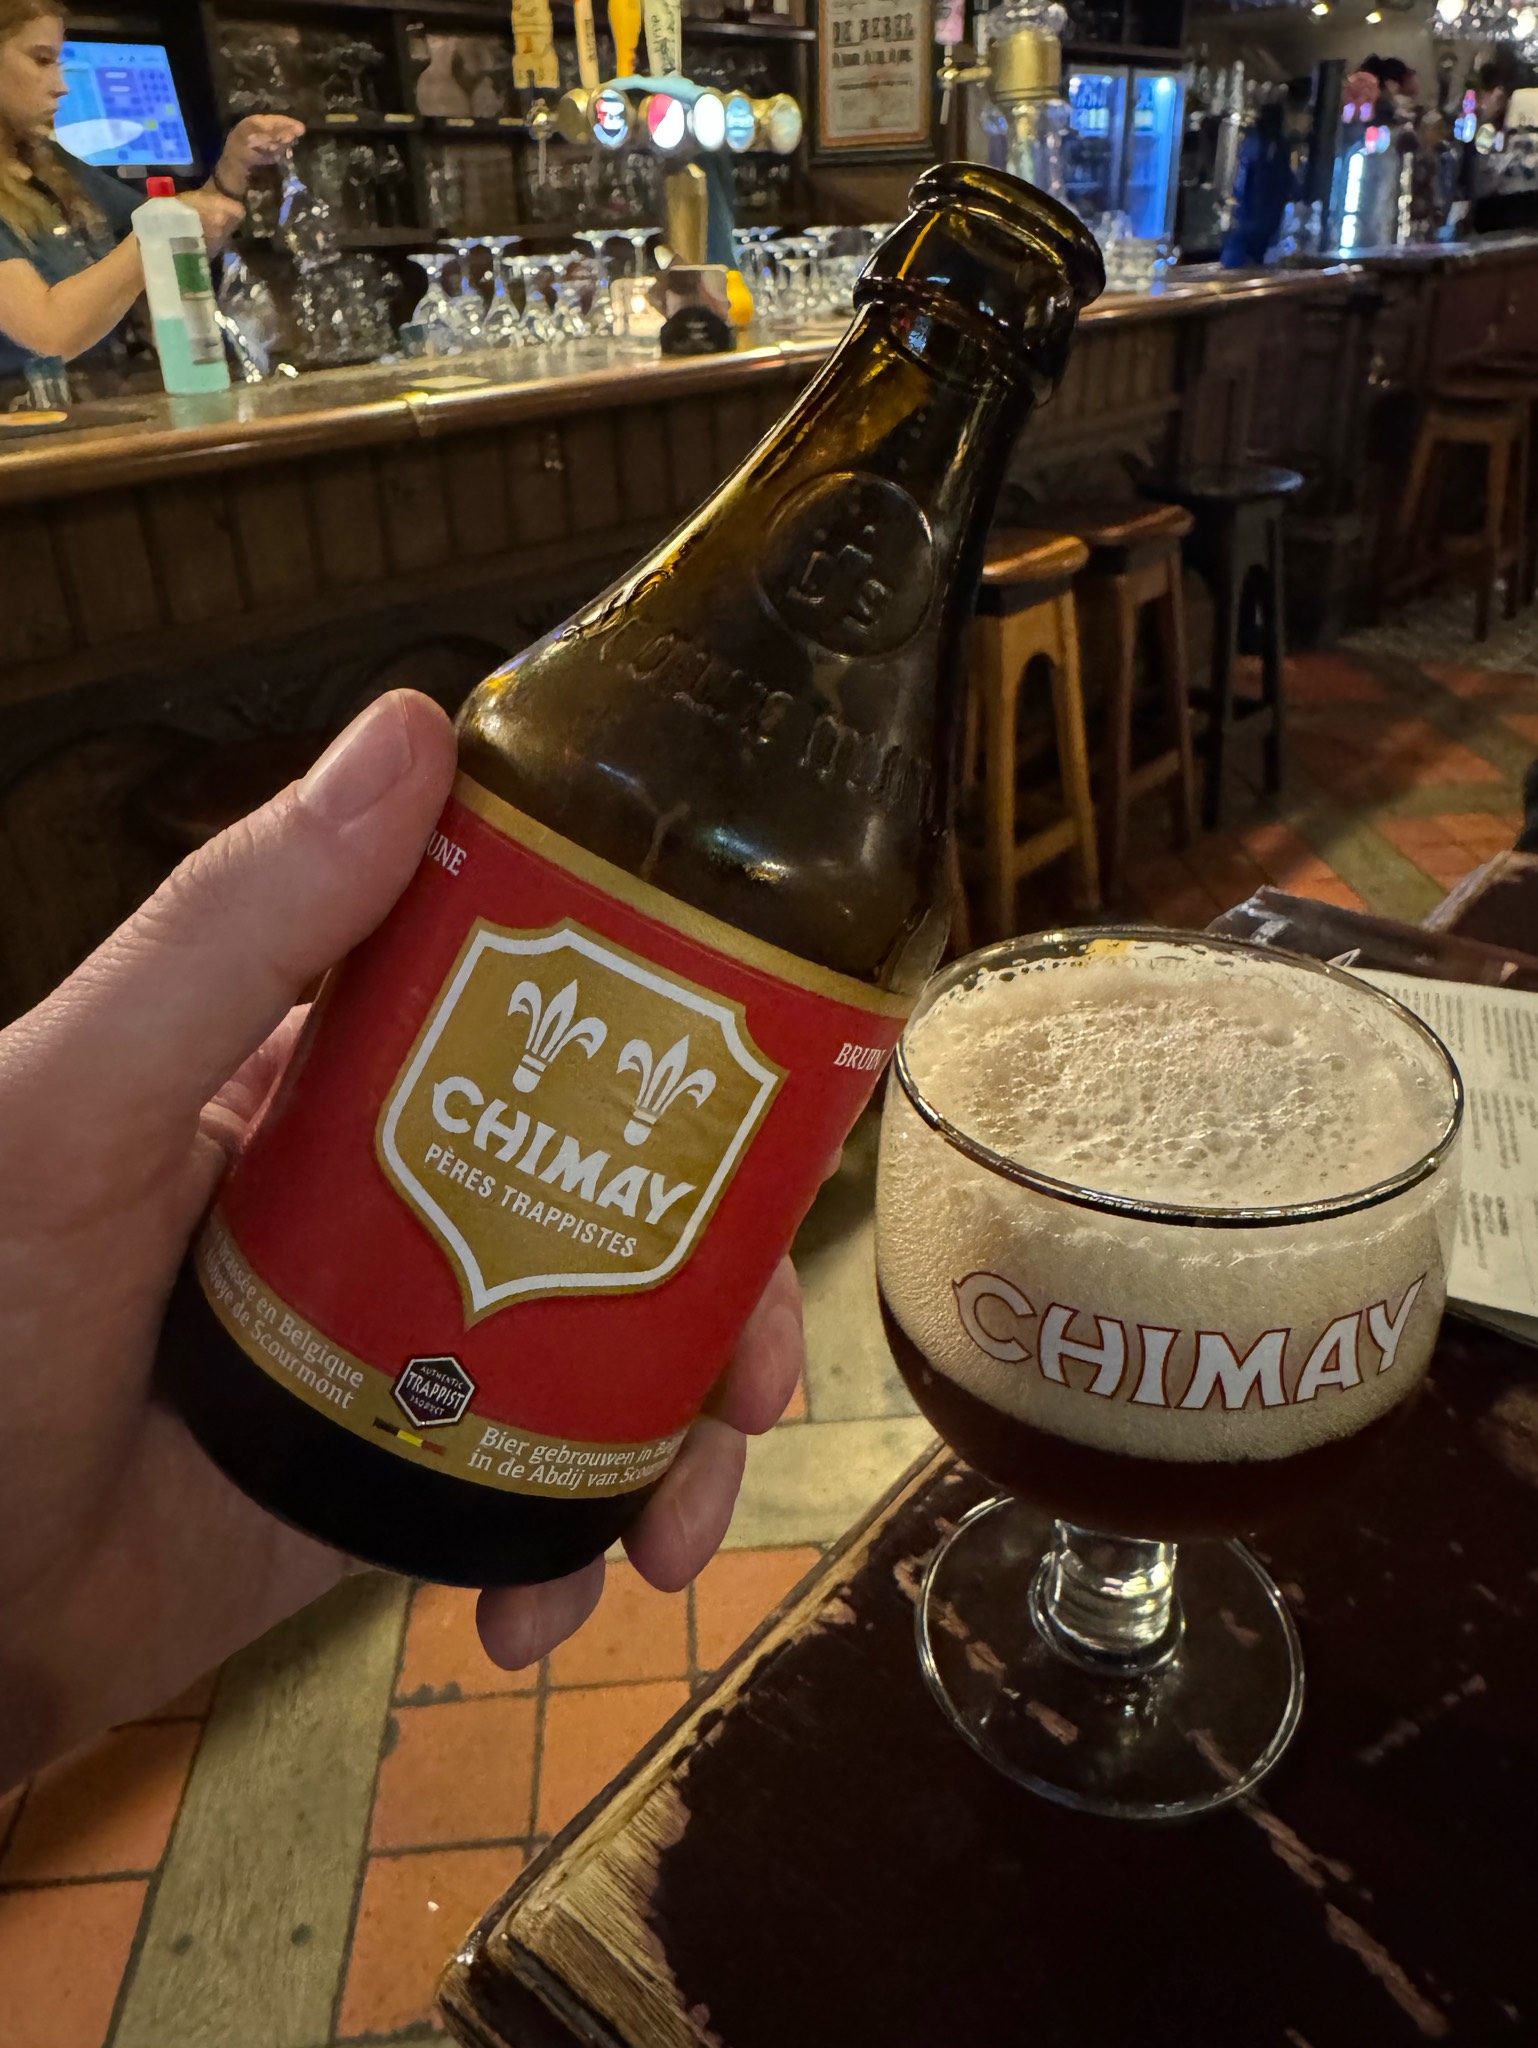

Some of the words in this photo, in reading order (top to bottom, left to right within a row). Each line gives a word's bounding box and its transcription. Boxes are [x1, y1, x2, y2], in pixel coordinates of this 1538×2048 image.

[427, 830, 467, 876] UNE
[432, 1076, 697, 1225] CHIMAY
[501, 1184, 637, 1257] TRAPPISTES
[232, 1299, 250, 1328] de
[251, 1319, 355, 1410] Scourmont
[256, 1297, 277, 1325] en
[278, 1312, 364, 1389] Belgique
[952, 1271, 1426, 1410] CHIMAY
[406, 1371, 466, 1410] TRAPPIST
[421, 1365, 464, 1390] AUTHENTIC
[467, 1448, 493, 1471] in
[497, 1456, 525, 1479] de
[526, 1463, 586, 1491] Abdij
[586, 1470, 617, 1487] van
[480, 1426, 529, 1455] Bier
[528, 1444, 637, 1466] gebrouwen
[635, 1448, 652, 1463] in
